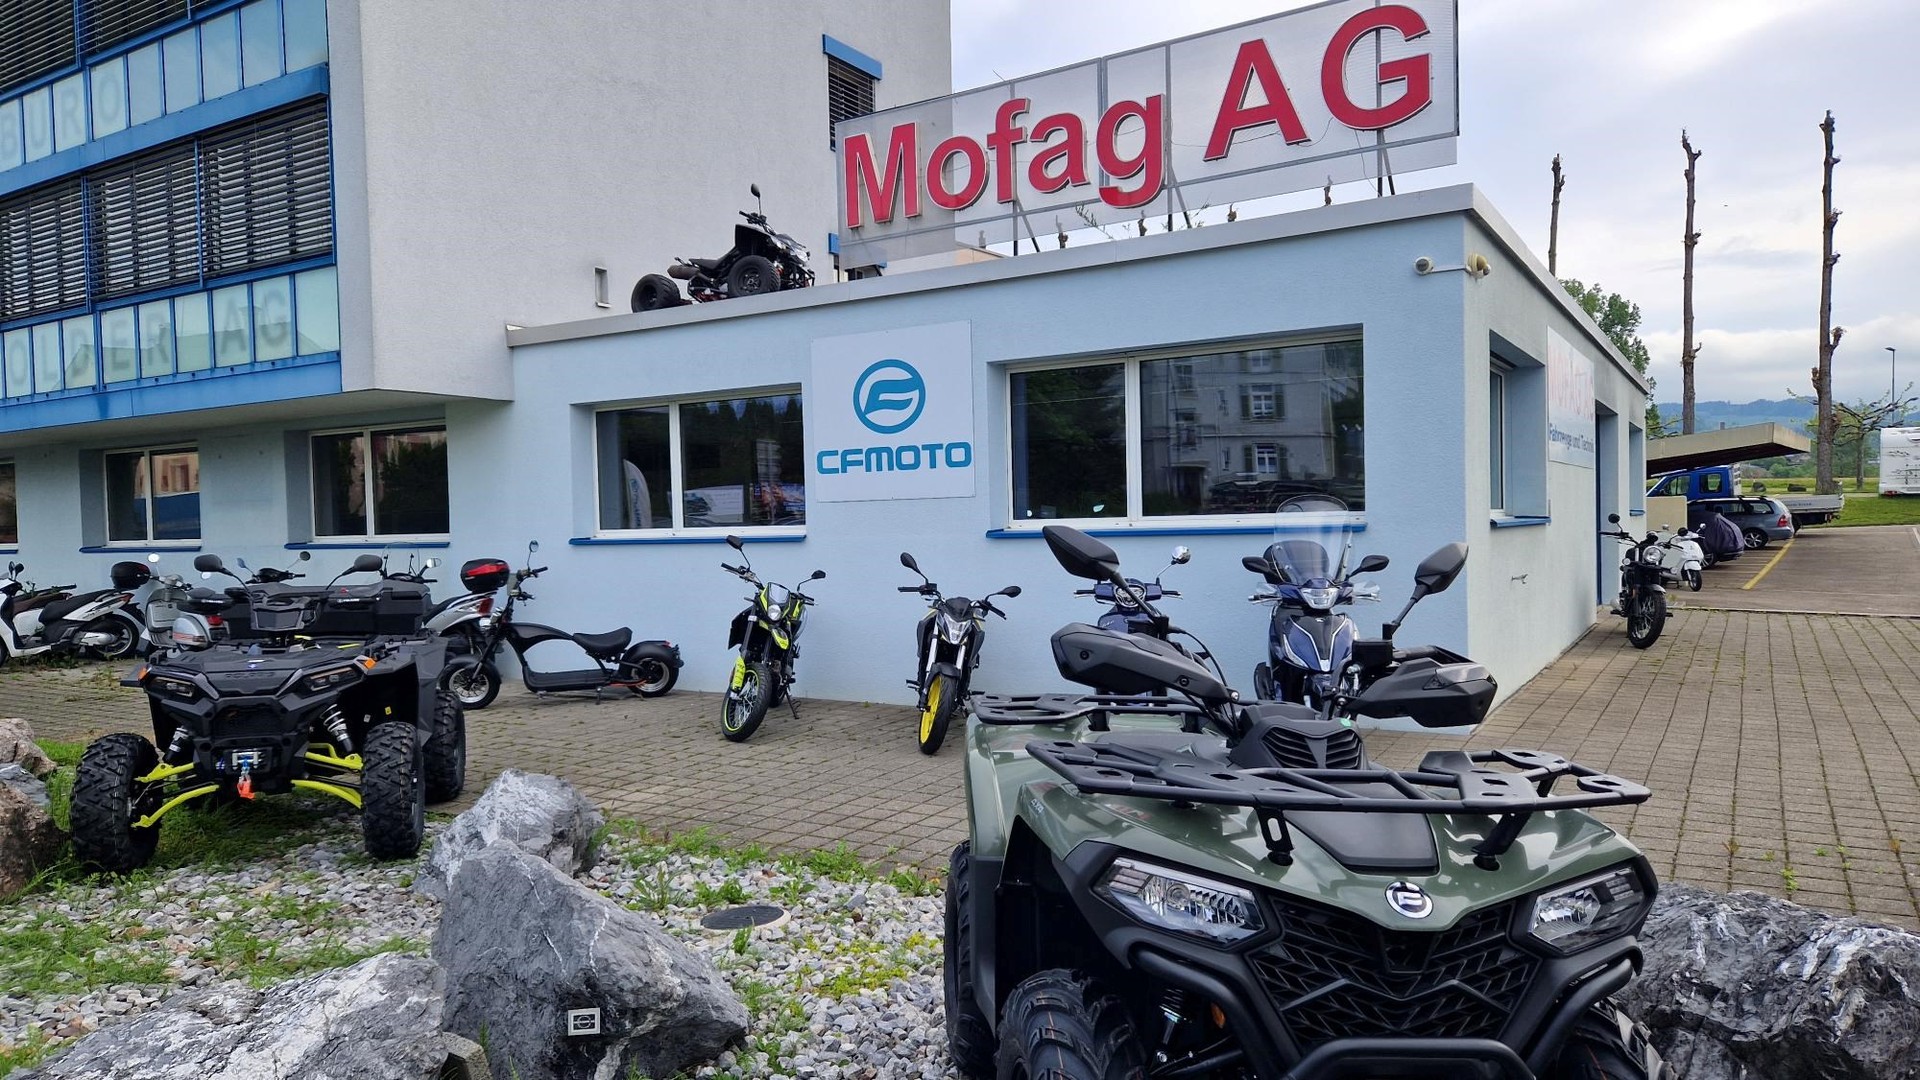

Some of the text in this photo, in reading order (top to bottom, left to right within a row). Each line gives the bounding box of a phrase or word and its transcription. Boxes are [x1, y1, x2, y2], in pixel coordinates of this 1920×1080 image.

[843, 5, 1433, 229] Mofag AG
[816, 441, 972, 475] CFMOTO
